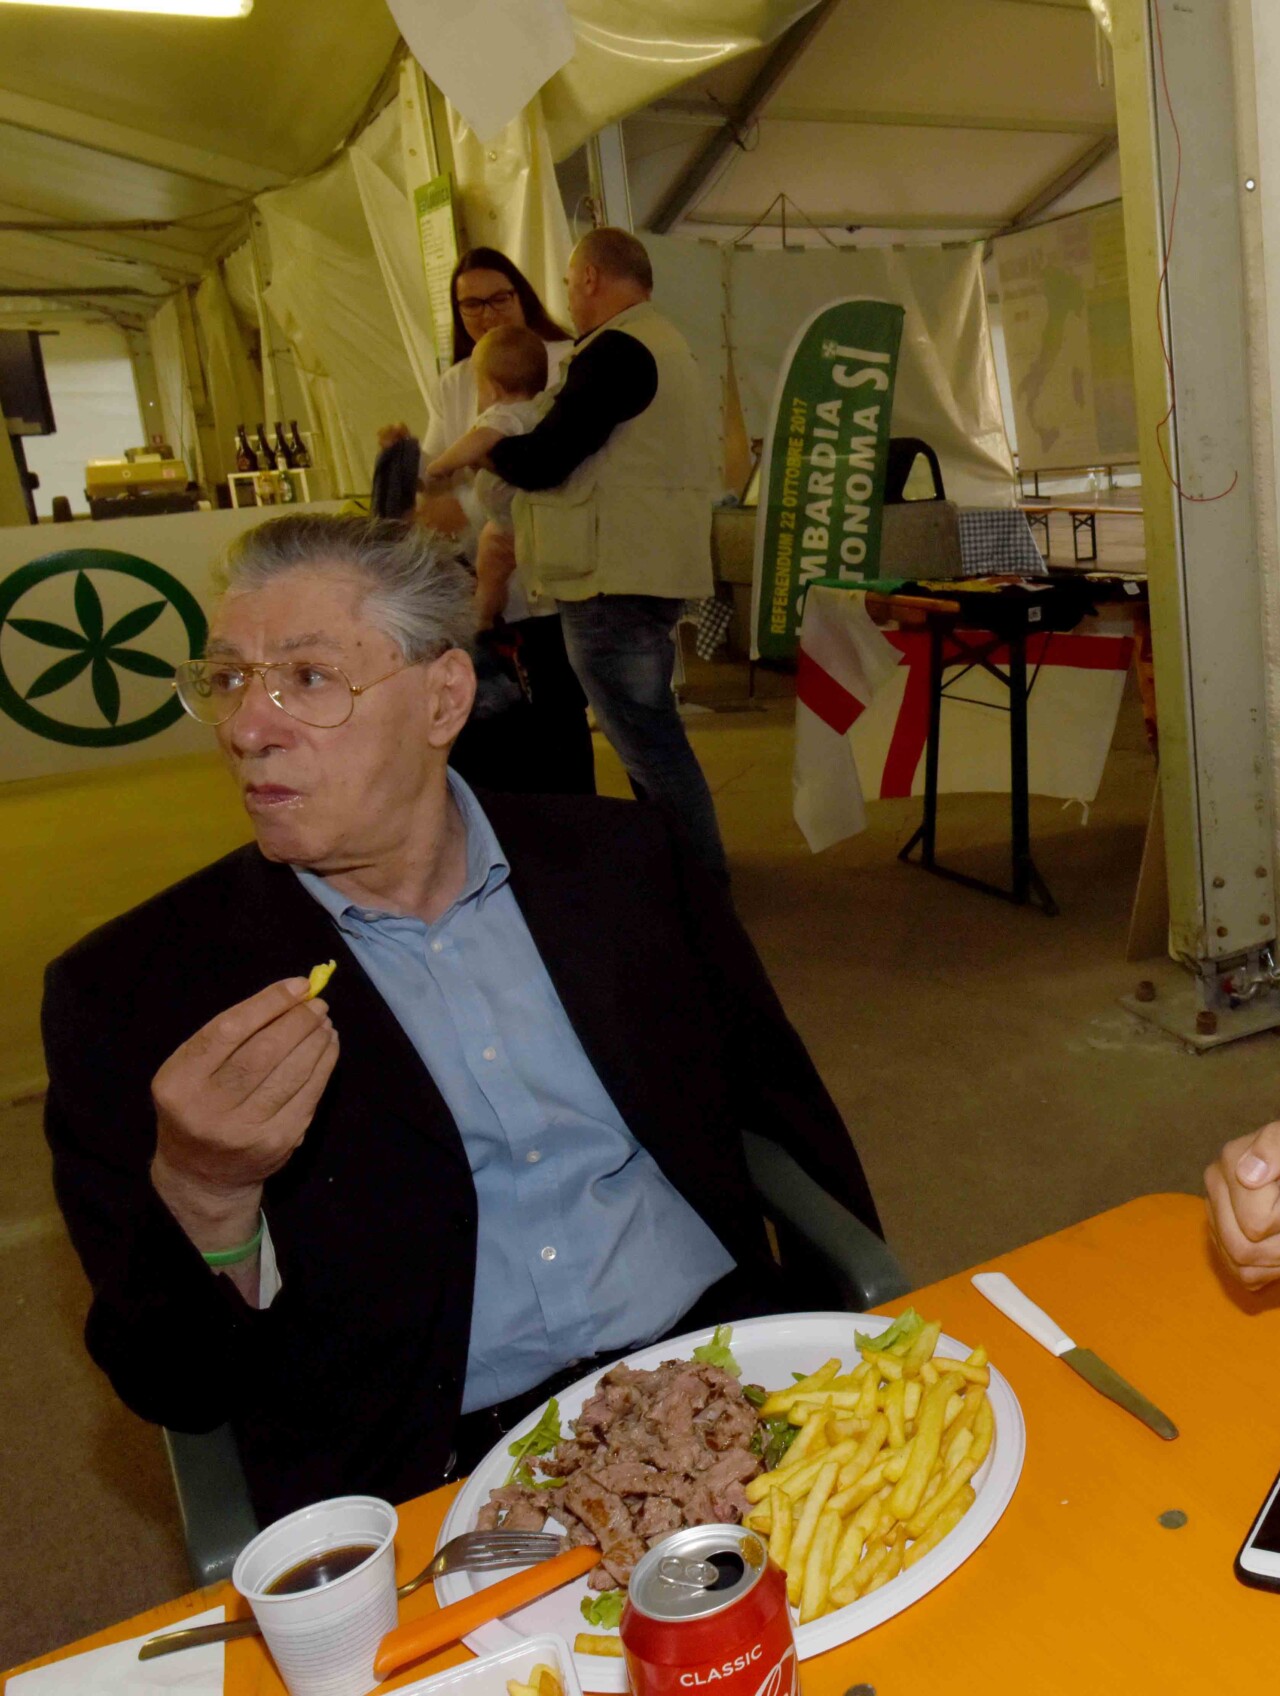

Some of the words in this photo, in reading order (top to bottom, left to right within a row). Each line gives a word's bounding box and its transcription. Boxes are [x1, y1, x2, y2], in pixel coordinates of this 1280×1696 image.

[790, 398, 808, 436] 2017
[782, 439, 805, 509] OTTOBRE
[839, 404, 881, 582] TONOMA
[781, 510, 796, 530] 22
[795, 399, 842, 637] MBARDIA
[770, 534, 796, 635] REFERENDUM
[680, 1643, 763, 1687] CLASSIC
